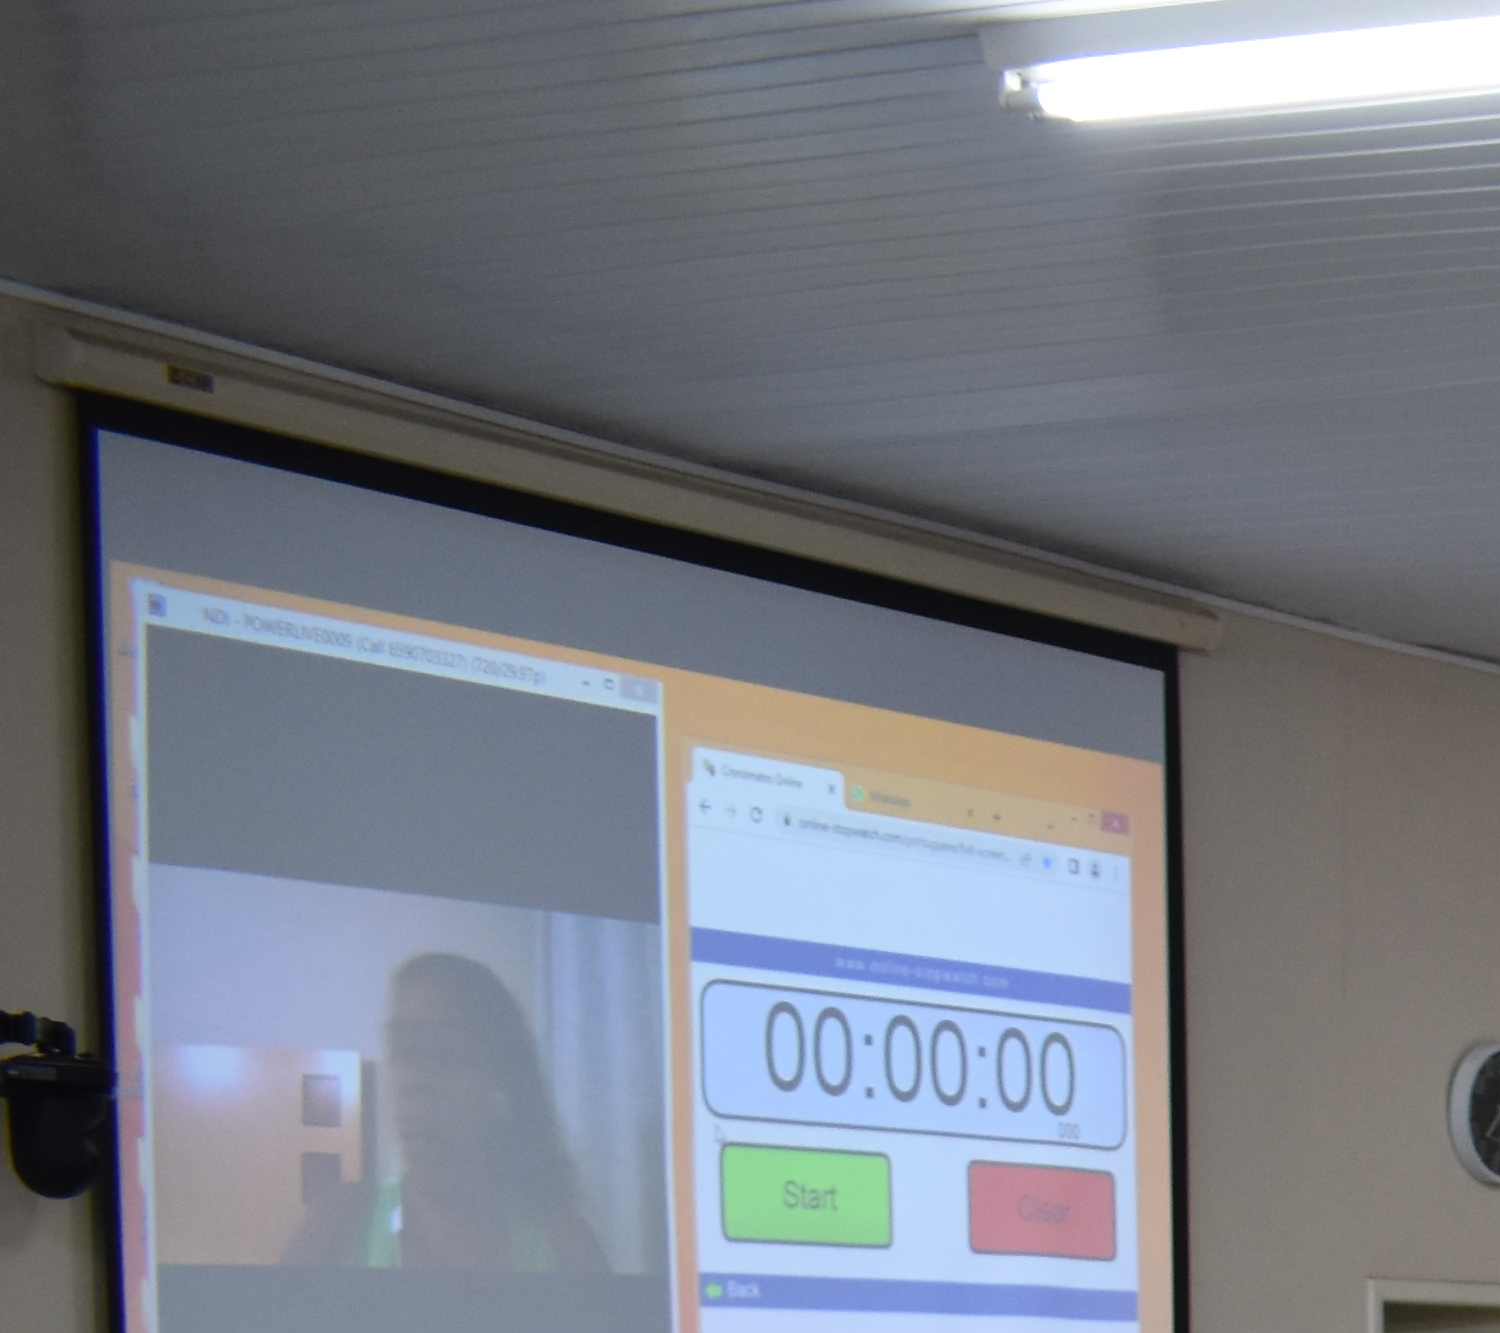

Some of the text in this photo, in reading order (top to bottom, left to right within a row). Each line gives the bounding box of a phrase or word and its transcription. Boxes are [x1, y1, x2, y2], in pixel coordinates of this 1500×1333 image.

[765, 1001, 1076, 1116] 00:00:00
[782, 1179, 838, 1212] Start
[1016, 1193, 1071, 1225] Clear
[726, 1279, 762, 1300] Back
